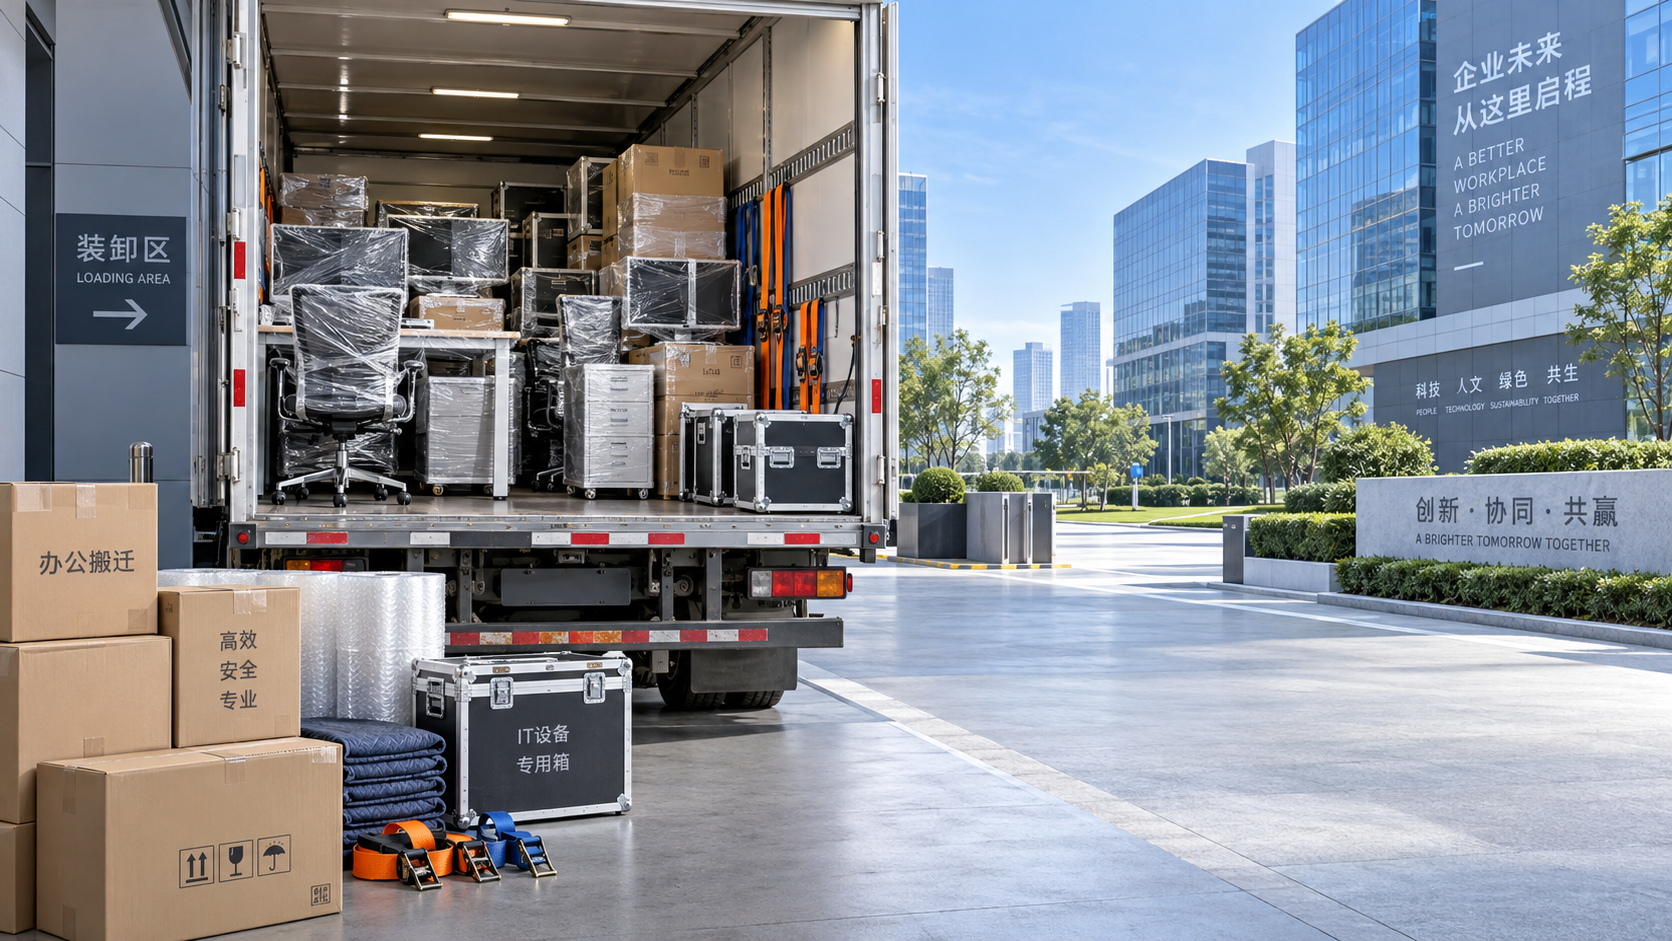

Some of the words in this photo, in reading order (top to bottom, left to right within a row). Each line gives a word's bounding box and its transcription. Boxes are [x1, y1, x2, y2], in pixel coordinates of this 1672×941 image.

[1452, 31, 1563, 94] 企业未来
[1452, 64, 1592, 136] 从这里启程
[1453, 156, 1463, 171] A
[1468, 137, 1525, 167] BETTER
[1453, 155, 1547, 194] WORKPLACE
[1453, 202, 1463, 217] A
[1468, 183, 1540, 214] BRIGHTER
[1453, 206, 1545, 240] TOMORROW
[77, 233, 171, 263] 装卸区
[77, 272, 134, 284] LOADING
[137, 273, 171, 285] AREA
[1416, 380, 1440, 400] 科技
[1456, 375, 1482, 395] 人文
[1499, 370, 1528, 390] 绿色
[1547, 363, 1579, 385] 共生
[1543, 393, 1580, 404] TOGETHER
[1416, 533, 1422, 544] A
[1425, 534, 1474, 546] BRIGHTER
[1476, 535, 1542, 550] TOMORROW
[1545, 537, 1610, 552] TOGETHER
[38, 549, 136, 576] 办公搬迁
[220, 629, 258, 651] 高效
[220, 659, 258, 681] 安全
[220, 689, 258, 711] 专业
[517, 724, 570, 745] IT设备
[516, 752, 570, 774] 专用箱
